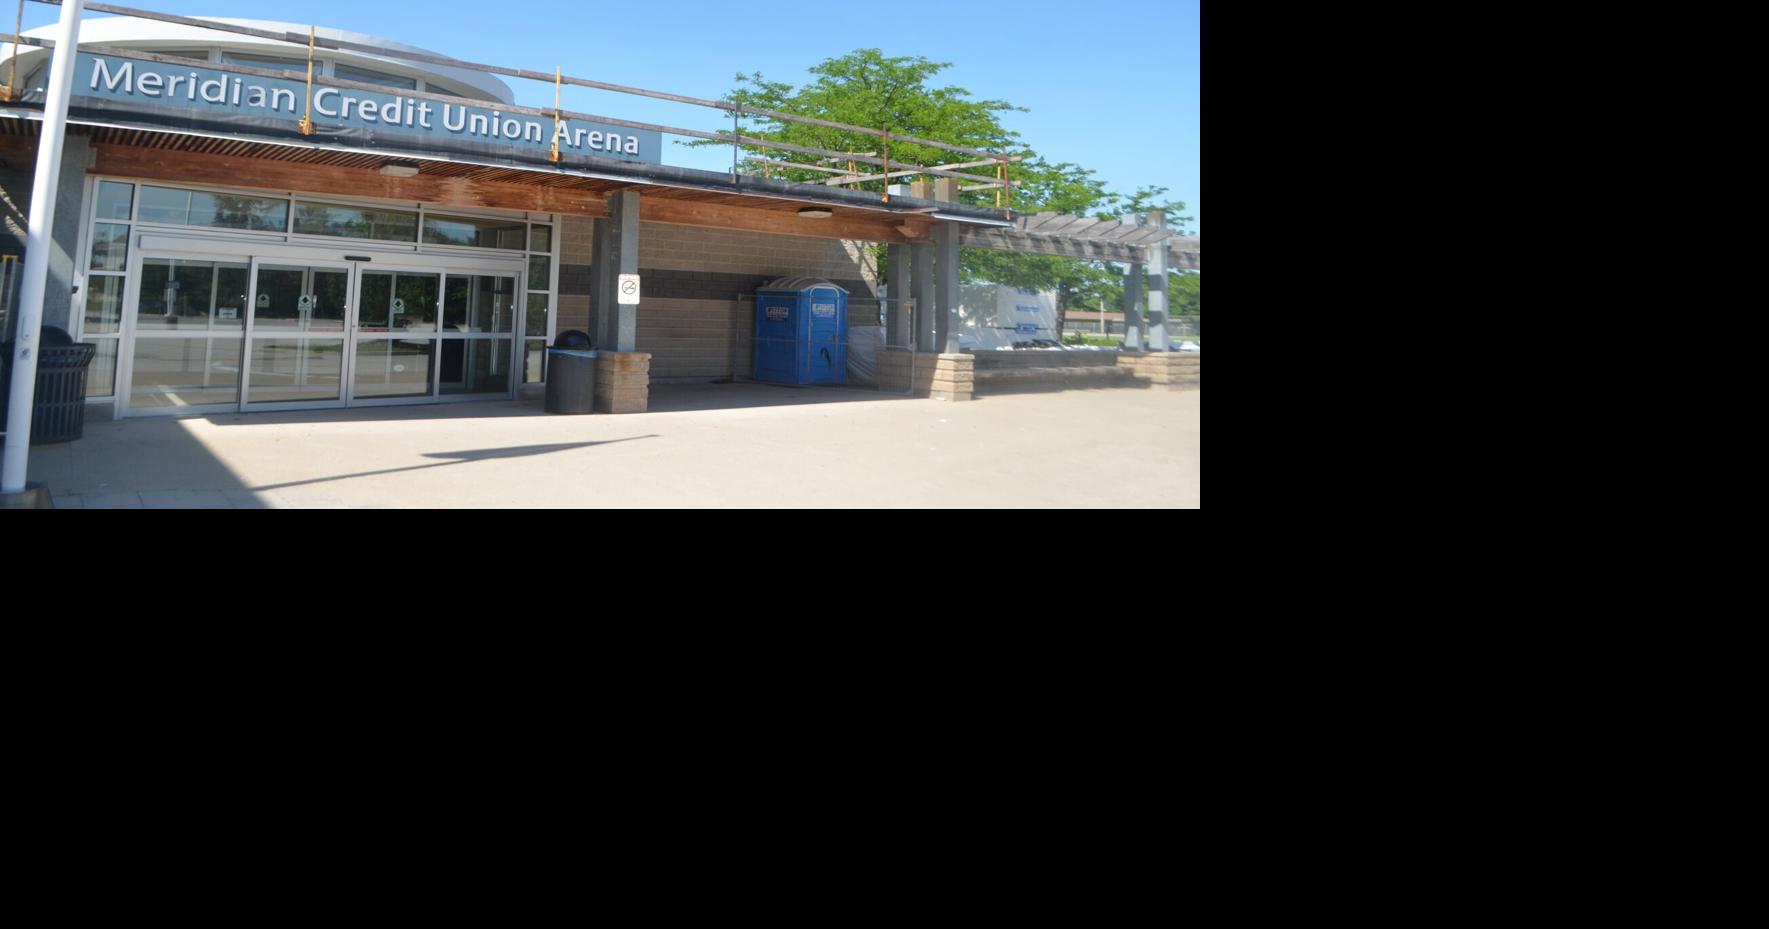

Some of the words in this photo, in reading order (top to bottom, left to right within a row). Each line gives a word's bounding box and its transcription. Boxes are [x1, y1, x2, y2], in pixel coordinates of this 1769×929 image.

[89, 57, 296, 112] Meridian
[313, 87, 432, 128] Credit
[443, 103, 542, 142] Union
[551, 119, 639, 154] Arena
